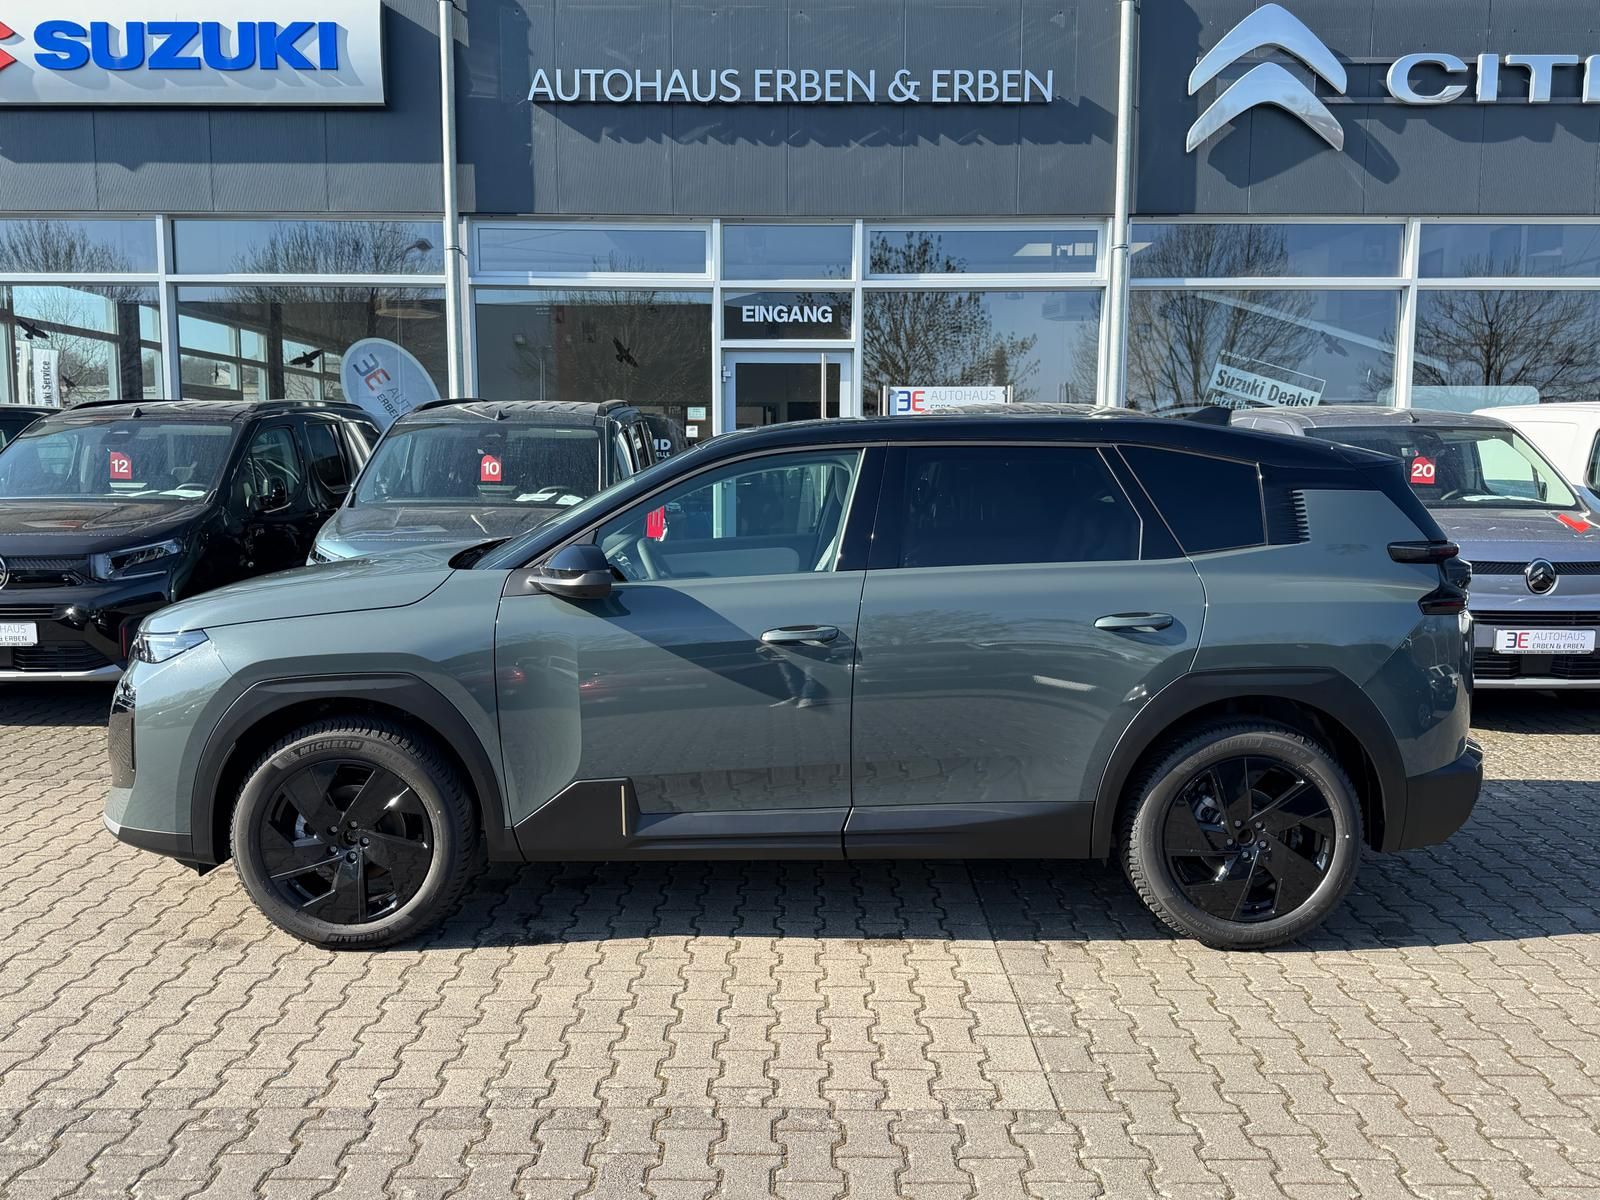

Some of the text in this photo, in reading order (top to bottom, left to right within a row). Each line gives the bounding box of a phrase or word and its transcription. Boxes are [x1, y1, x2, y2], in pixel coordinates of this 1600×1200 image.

[34, 20, 338, 71] SUZUKI
[528, 68, 1054, 102] AUTOHAUS ERBEN & ERBEN
[742, 305, 832, 324] EINGANG
[40, 360, 52, 390] Service
[1216, 369, 1266, 398] Suzuki
[930, 390, 996, 401] AUTOHAUS
[112, 459, 128, 473] 12
[483, 461, 499, 475] 10
[1412, 463, 1435, 477] 20
[1533, 632, 1586, 641] AUTOHAUS
[299, 740, 362, 756] MICHELIN
